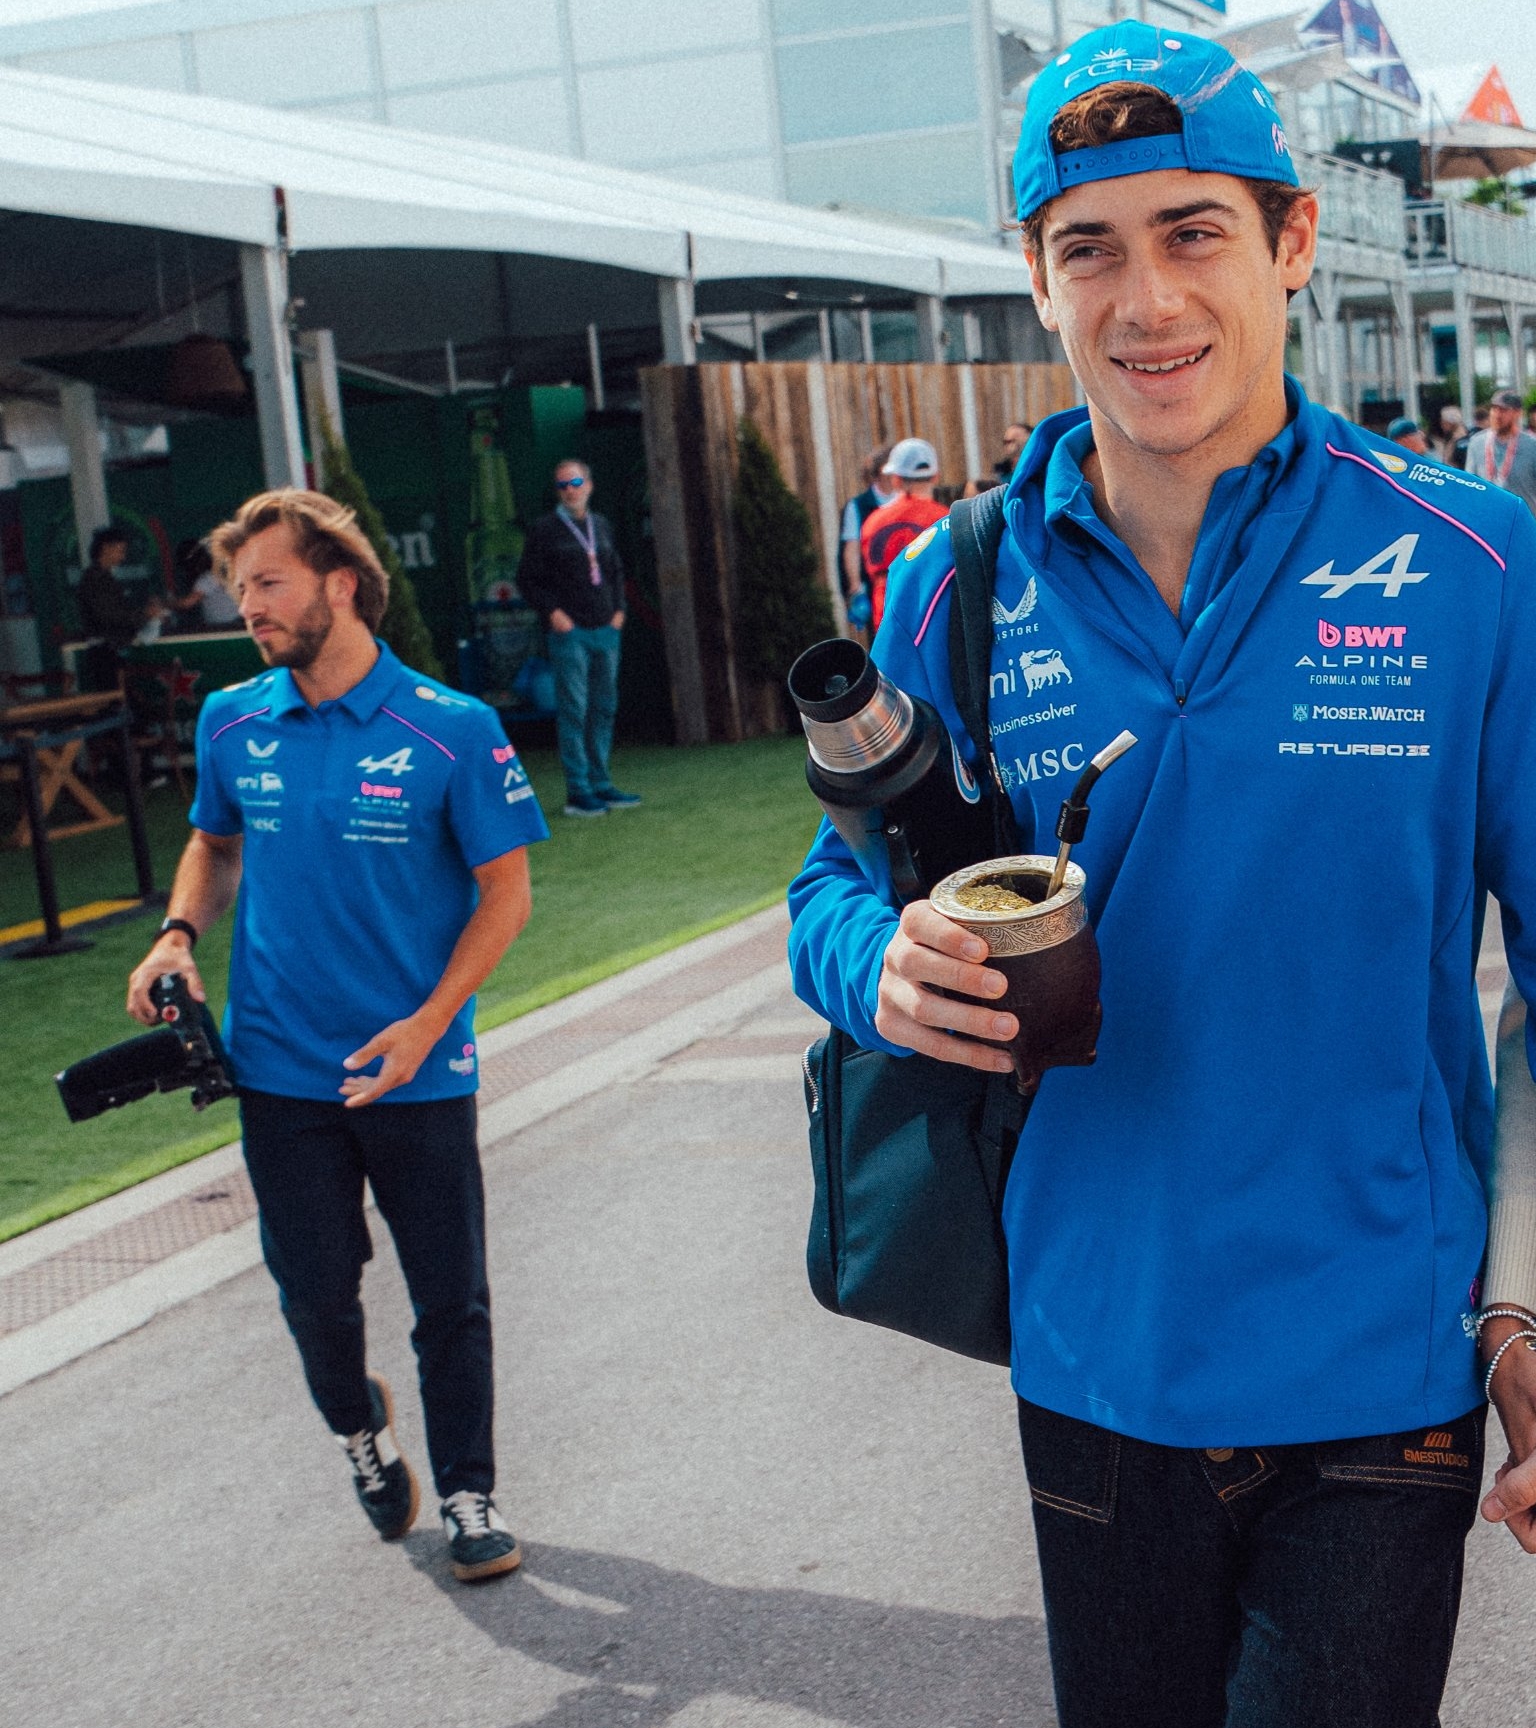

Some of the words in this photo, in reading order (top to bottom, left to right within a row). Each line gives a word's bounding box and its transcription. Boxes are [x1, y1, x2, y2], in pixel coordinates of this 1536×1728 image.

[1408, 470, 1445, 486] libre
[1412, 463, 1487, 491] mercado
[994, 623, 1039, 644] STORE
[1344, 626, 1407, 648] BWT
[1294, 654, 1428, 669] ALPINE
[990, 658, 1017, 699] ni
[1310, 674, 1357, 686] FORMULA
[1361, 675, 1381, 686] ONE
[1385, 676, 1412, 686] TEAM
[992, 703, 1078, 736] businessolver
[1014, 743, 1086, 785] MSC
[1403, 1448, 1470, 1468] EMESTUDIOS
